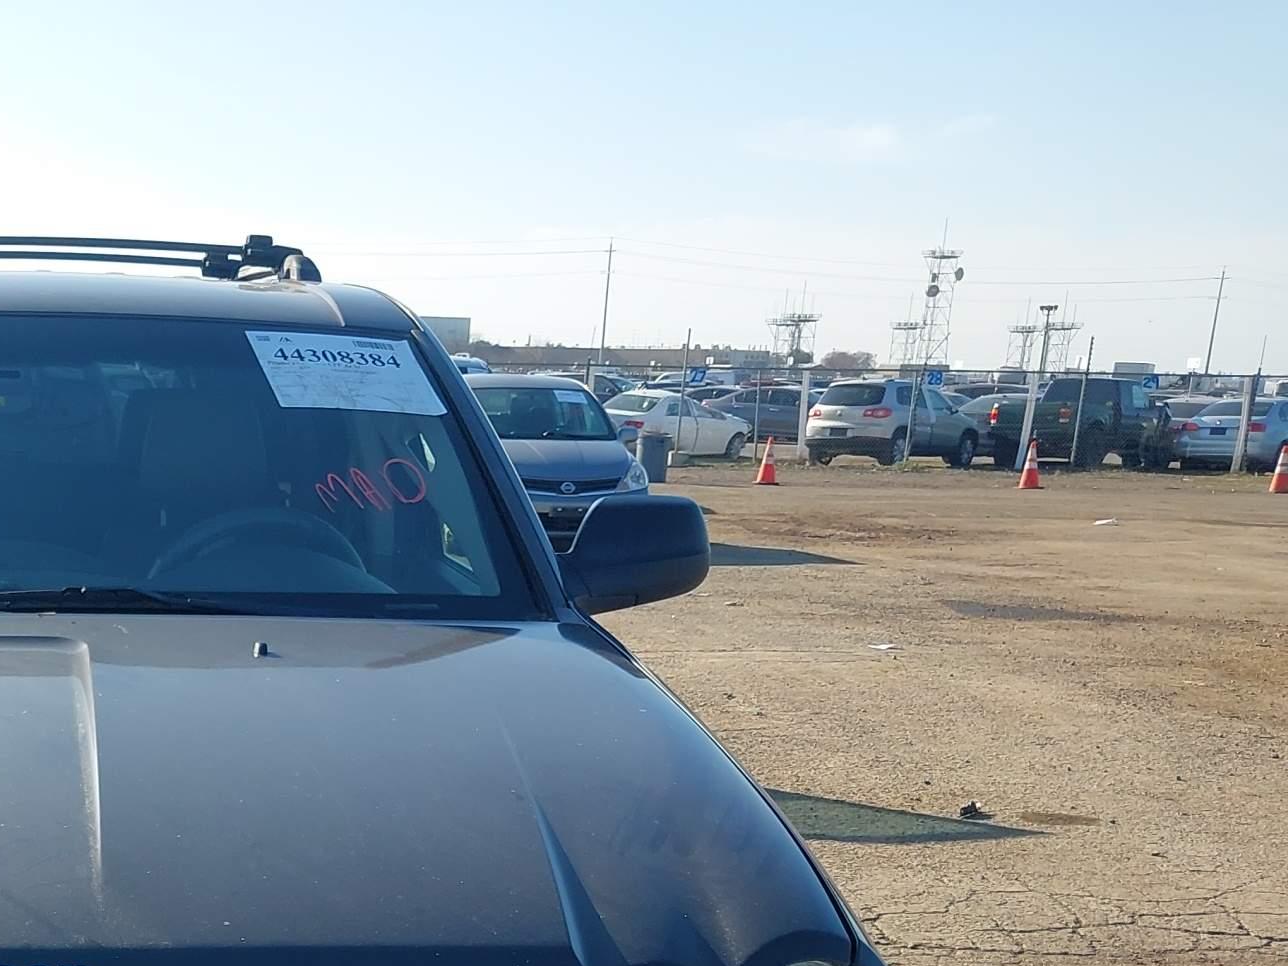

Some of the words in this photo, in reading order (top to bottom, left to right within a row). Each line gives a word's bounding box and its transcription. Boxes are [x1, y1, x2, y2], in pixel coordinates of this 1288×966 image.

[274, 347, 401, 368] 44308384
[689, 368, 706, 382] 27
[927, 372, 943, 385] 28
